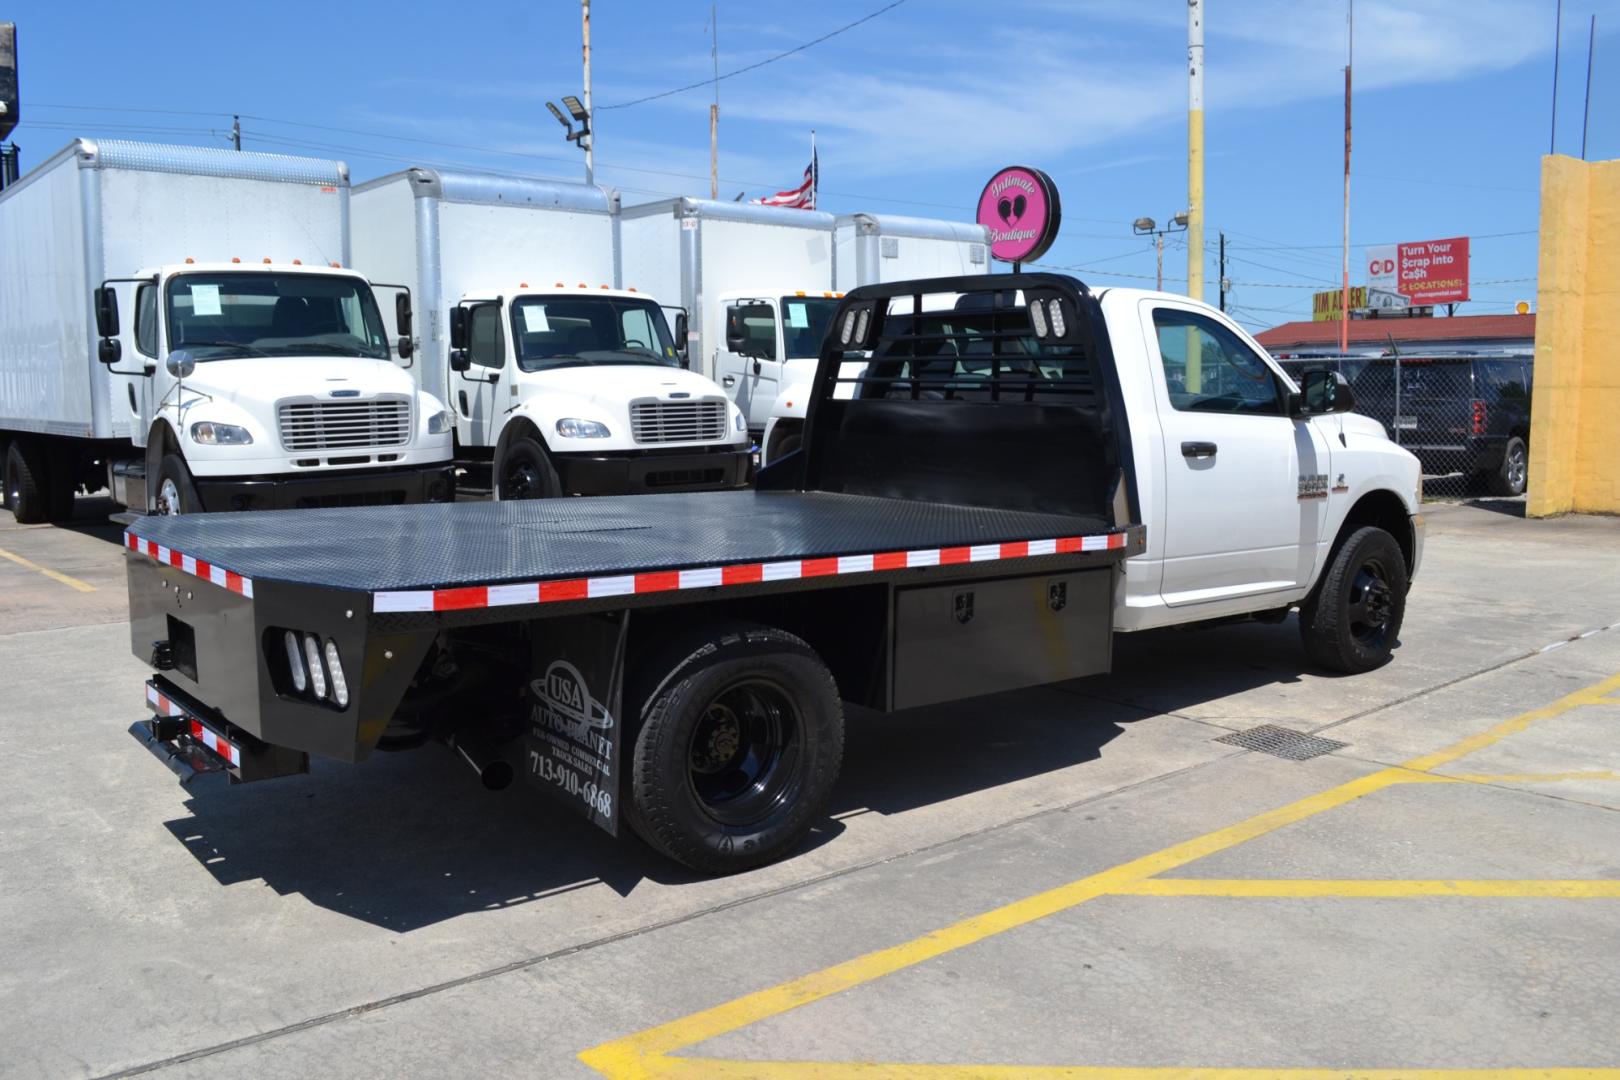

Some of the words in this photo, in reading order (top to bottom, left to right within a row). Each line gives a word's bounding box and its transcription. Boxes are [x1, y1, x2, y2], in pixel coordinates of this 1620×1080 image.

[991, 175, 1035, 197] Intimate
[991, 228, 1035, 242] Boutique
[1402, 246, 1425, 256] Turn
[1427, 244, 1451, 253] Your
[1432, 255, 1454, 265] into
[1402, 267, 1427, 280] Ca$h
[551, 675, 583, 710] USA
[573, 757, 593, 777] SALES
[529, 750, 612, 818] 713-910-6868
